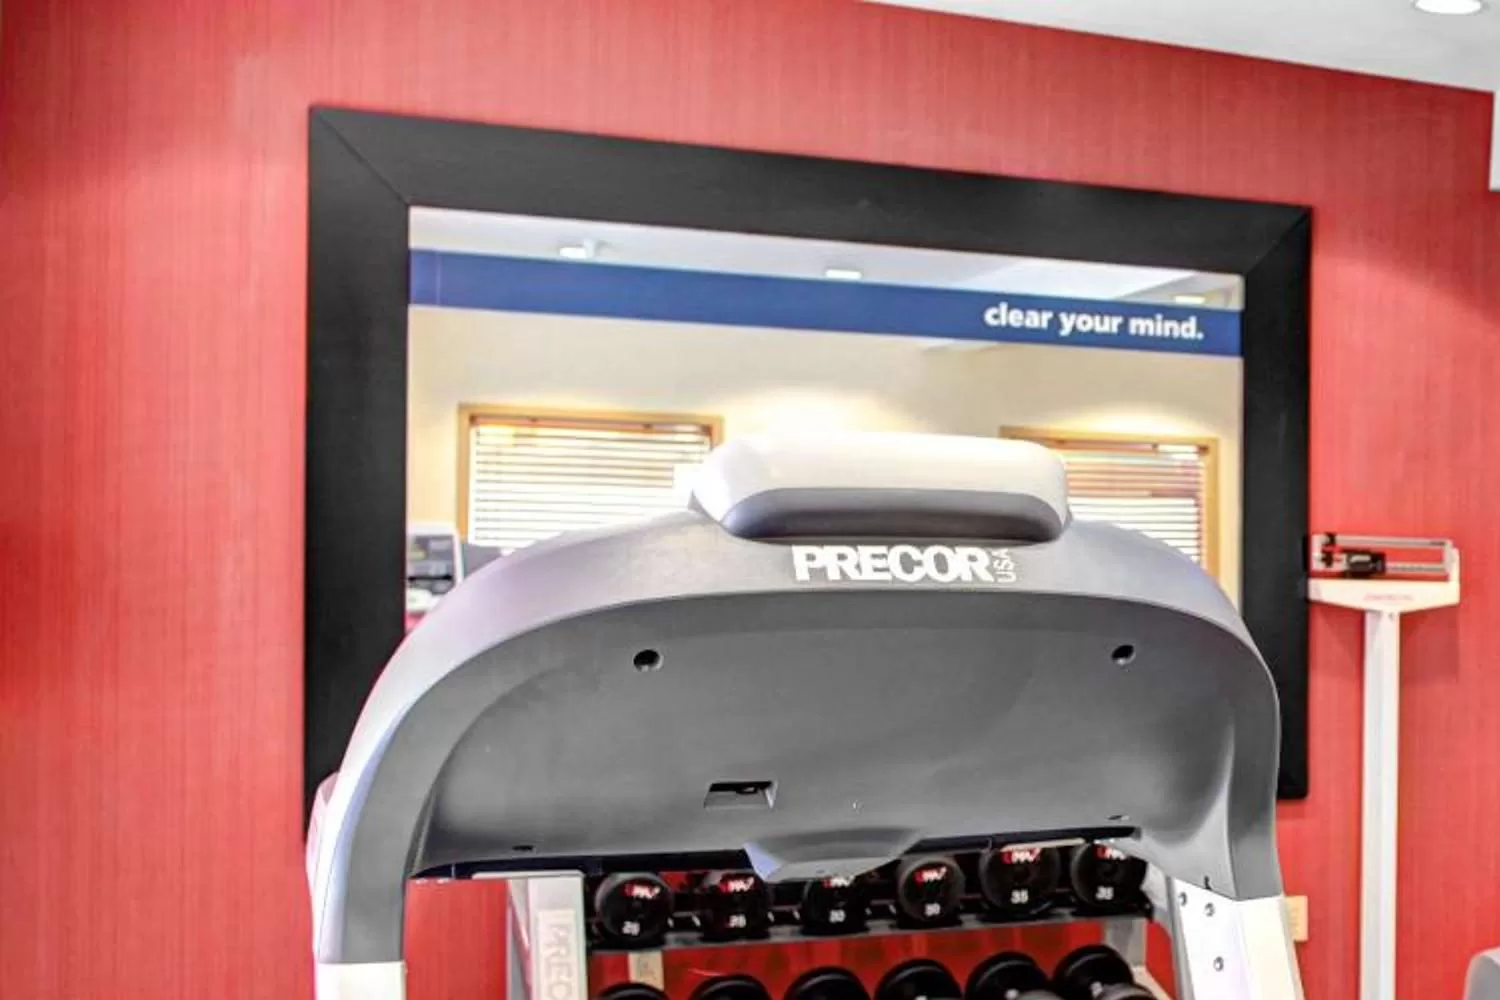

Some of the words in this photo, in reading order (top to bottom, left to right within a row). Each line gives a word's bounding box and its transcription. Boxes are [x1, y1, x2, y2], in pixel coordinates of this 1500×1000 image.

[984, 302, 1053, 328] clear
[1060, 311, 1122, 336] your
[1129, 316, 1204, 340] mind.
[791, 544, 994, 583] PRECOR
